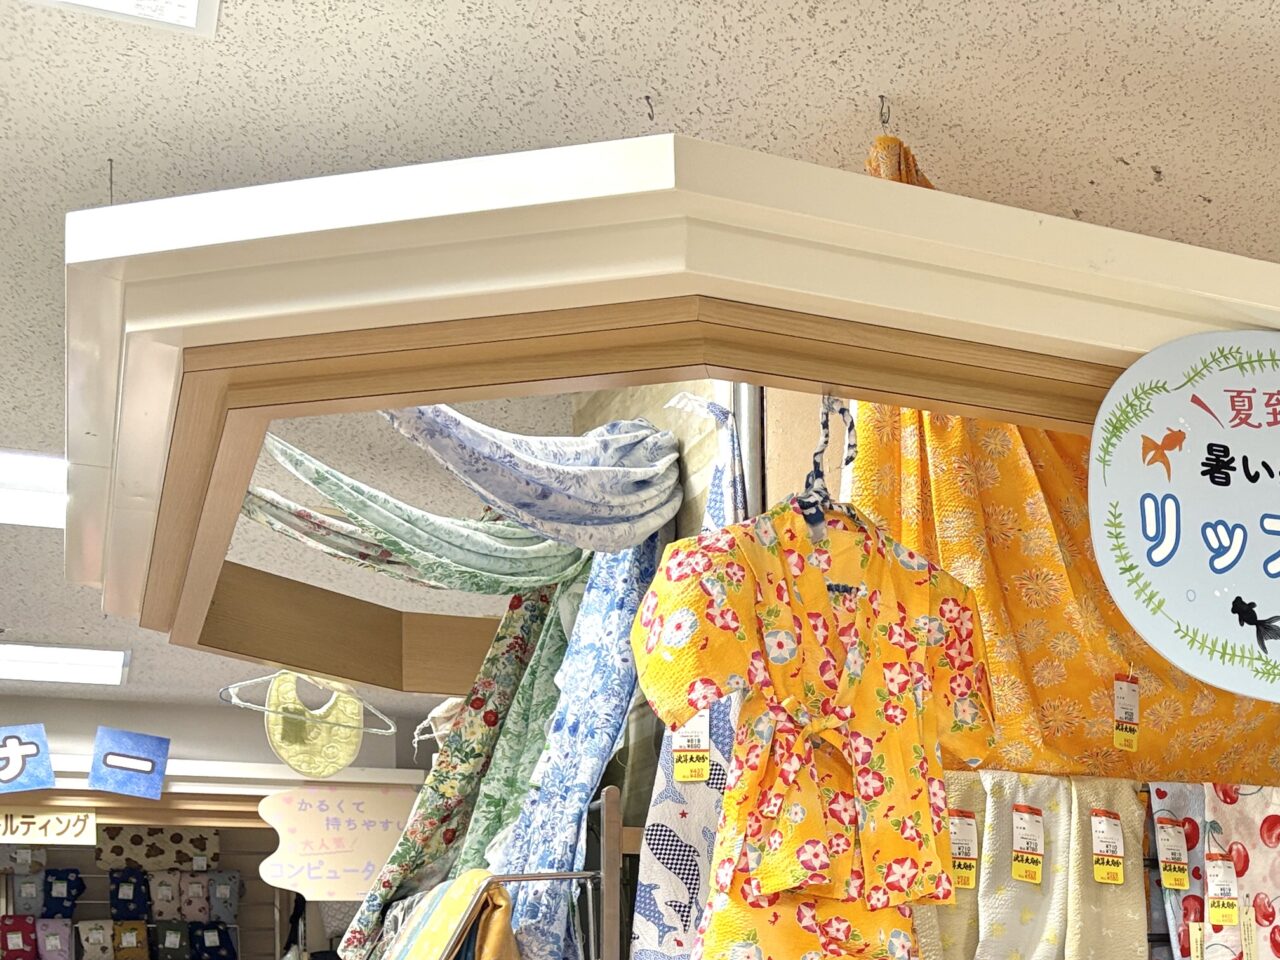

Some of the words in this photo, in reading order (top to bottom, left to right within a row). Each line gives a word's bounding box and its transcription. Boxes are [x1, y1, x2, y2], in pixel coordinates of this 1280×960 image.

[298, 800, 365, 814] かるくて
[0, 813, 89, 838] ルティング
